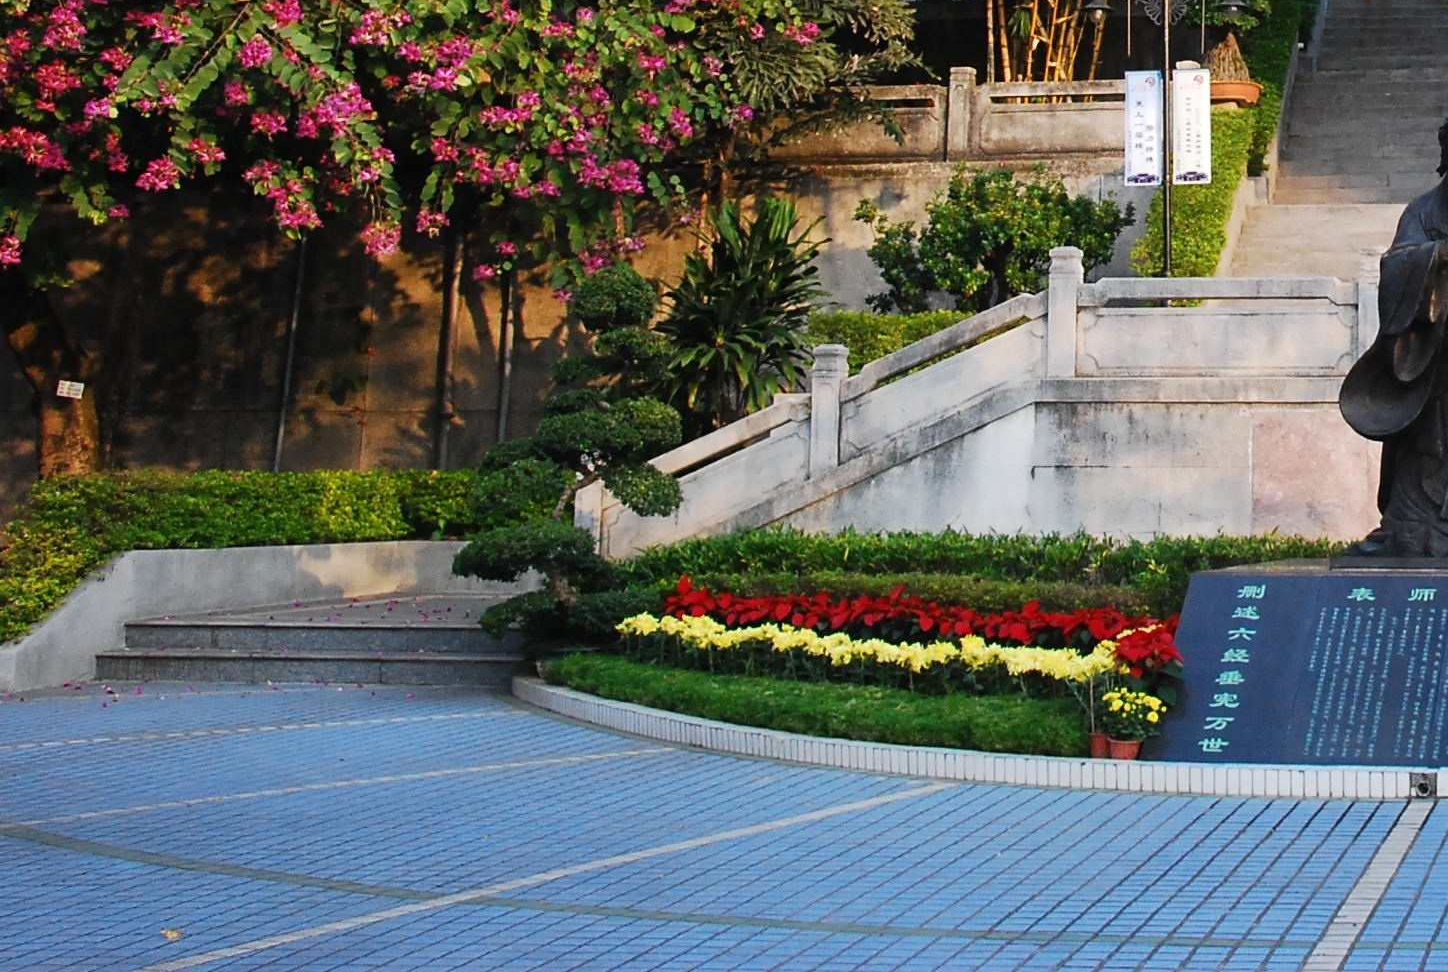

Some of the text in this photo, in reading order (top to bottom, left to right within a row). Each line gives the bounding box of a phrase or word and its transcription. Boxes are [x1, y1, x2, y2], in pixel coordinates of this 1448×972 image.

[1198, 584, 1267, 753] 删述六经垂宪万世
